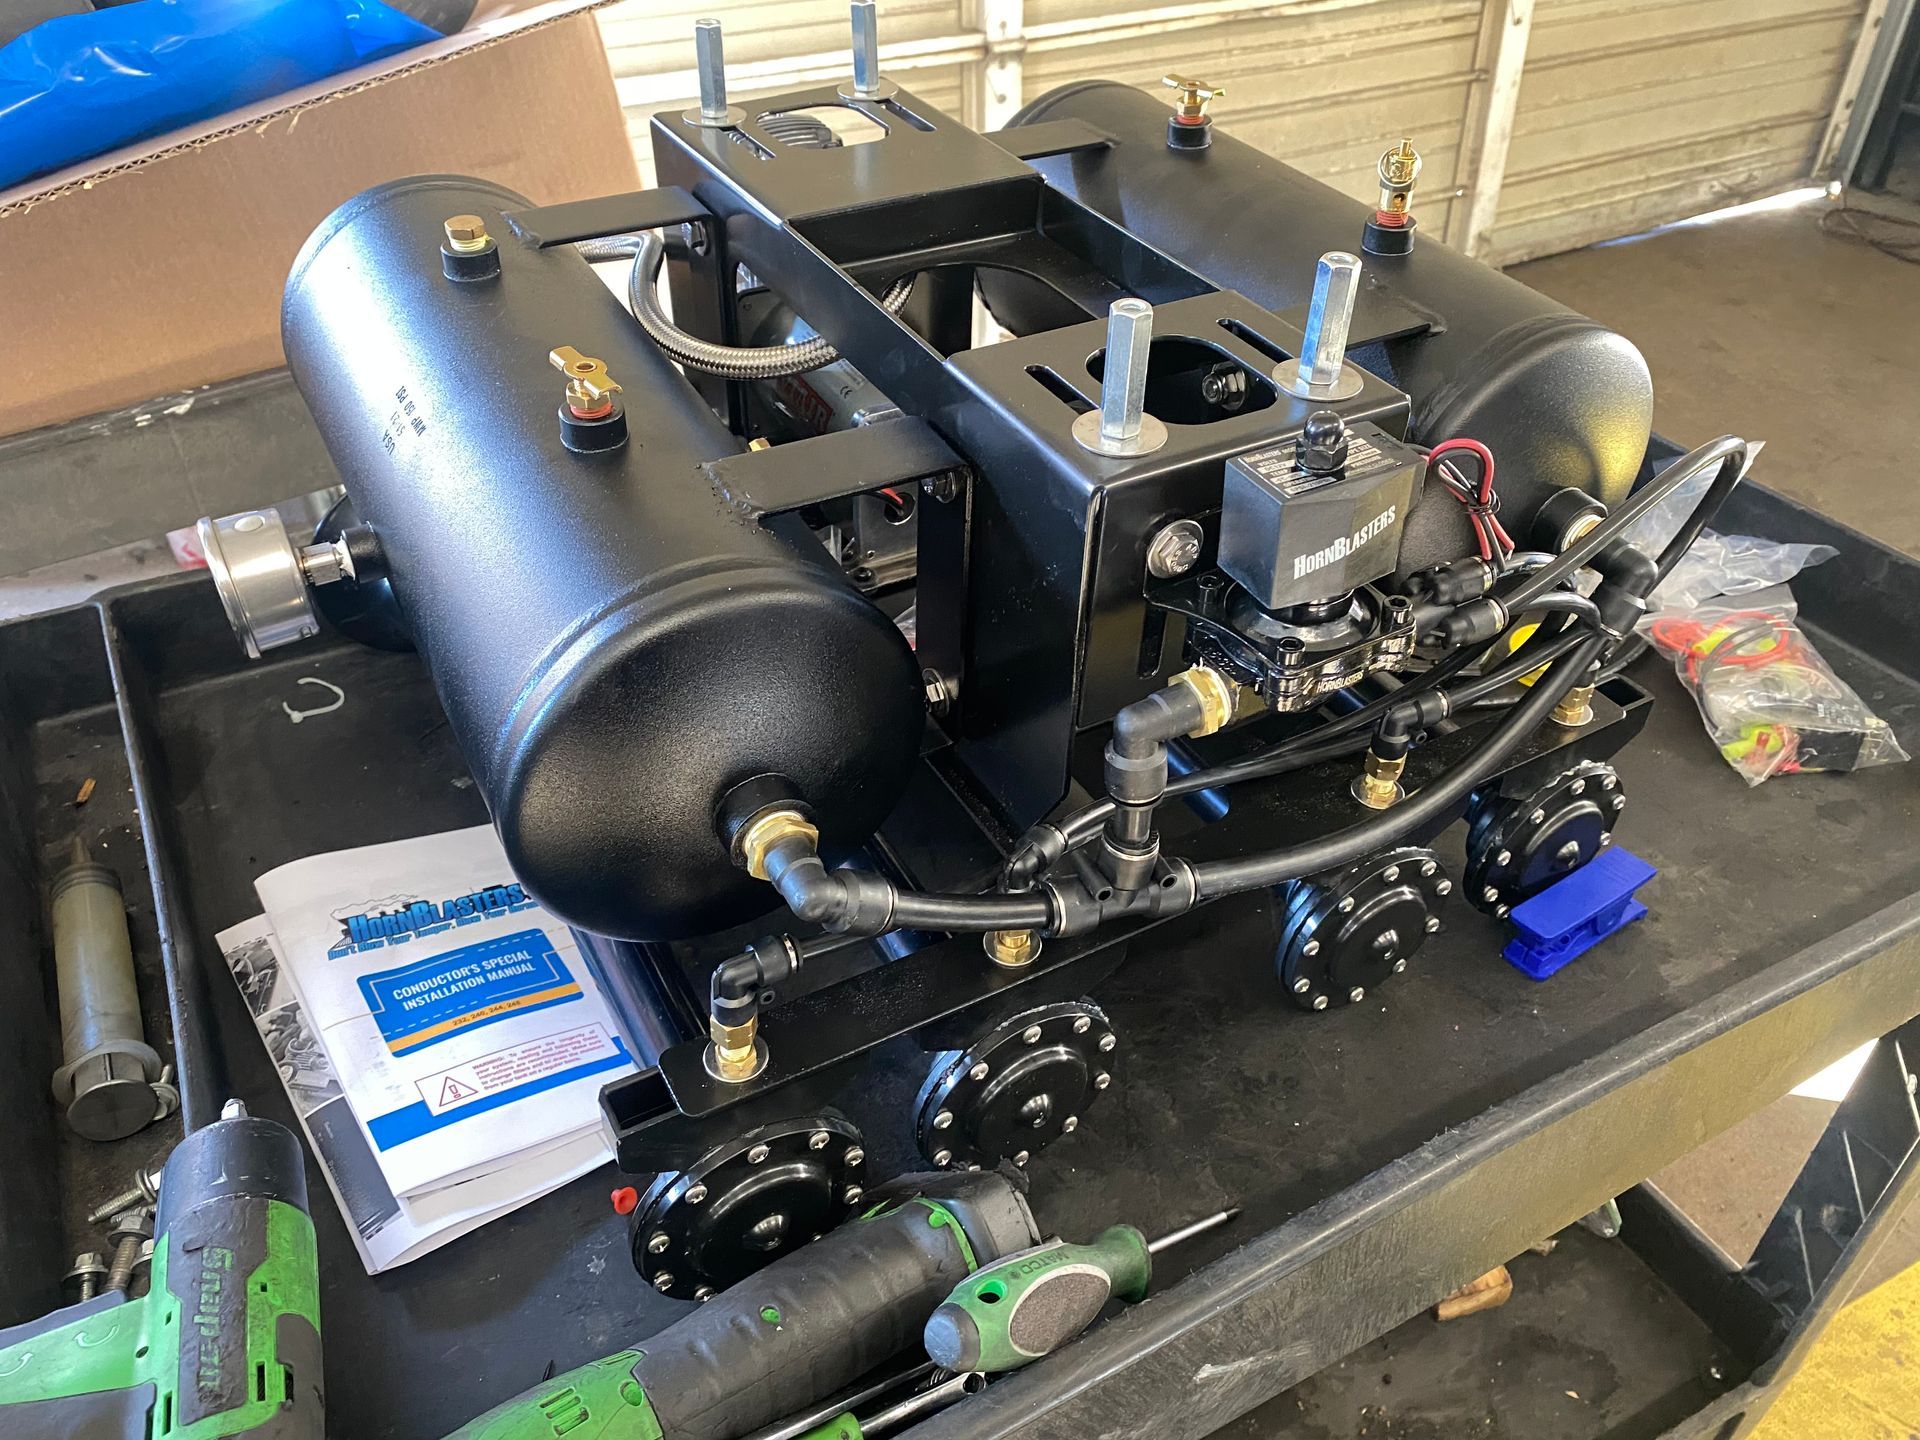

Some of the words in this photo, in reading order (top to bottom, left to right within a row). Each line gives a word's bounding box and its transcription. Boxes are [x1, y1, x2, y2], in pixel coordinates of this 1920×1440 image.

[395, 385, 409, 404] PSI
[404, 400, 416, 416] 150
[382, 428, 396, 455] USA
[1294, 505, 1396, 580] HORNBLASTERS
[347, 883, 525, 943] HORNBLASTERS
[392, 963, 481, 1001] CONDUCTOR'S
[484, 950, 533, 971] SPECIAL
[402, 975, 486, 1012] INSTALLATION
[487, 962, 537, 983] MANUAL
[1019, 1252, 1071, 1275] MATCO
